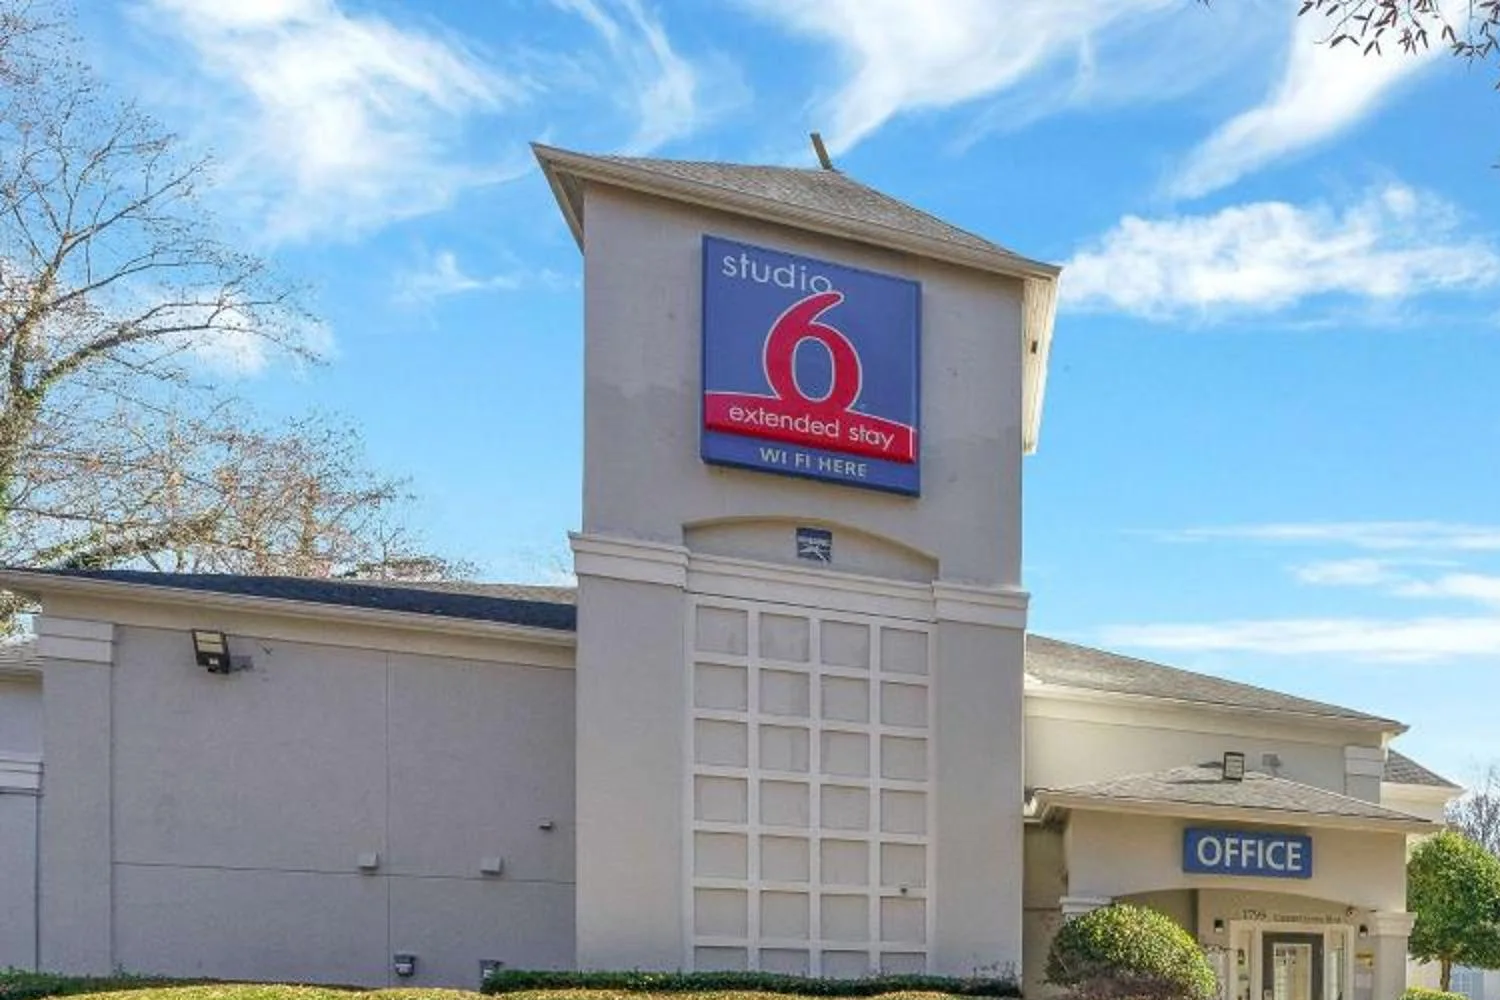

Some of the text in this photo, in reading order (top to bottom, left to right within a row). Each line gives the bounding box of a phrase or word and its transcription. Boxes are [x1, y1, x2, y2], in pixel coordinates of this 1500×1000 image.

[722, 253, 832, 293] studio
[762, 290, 863, 409] 6
[729, 406, 895, 450] extended stay
[760, 447, 868, 478] WI FI HERE
[1197, 836, 1303, 871] OFFICE
